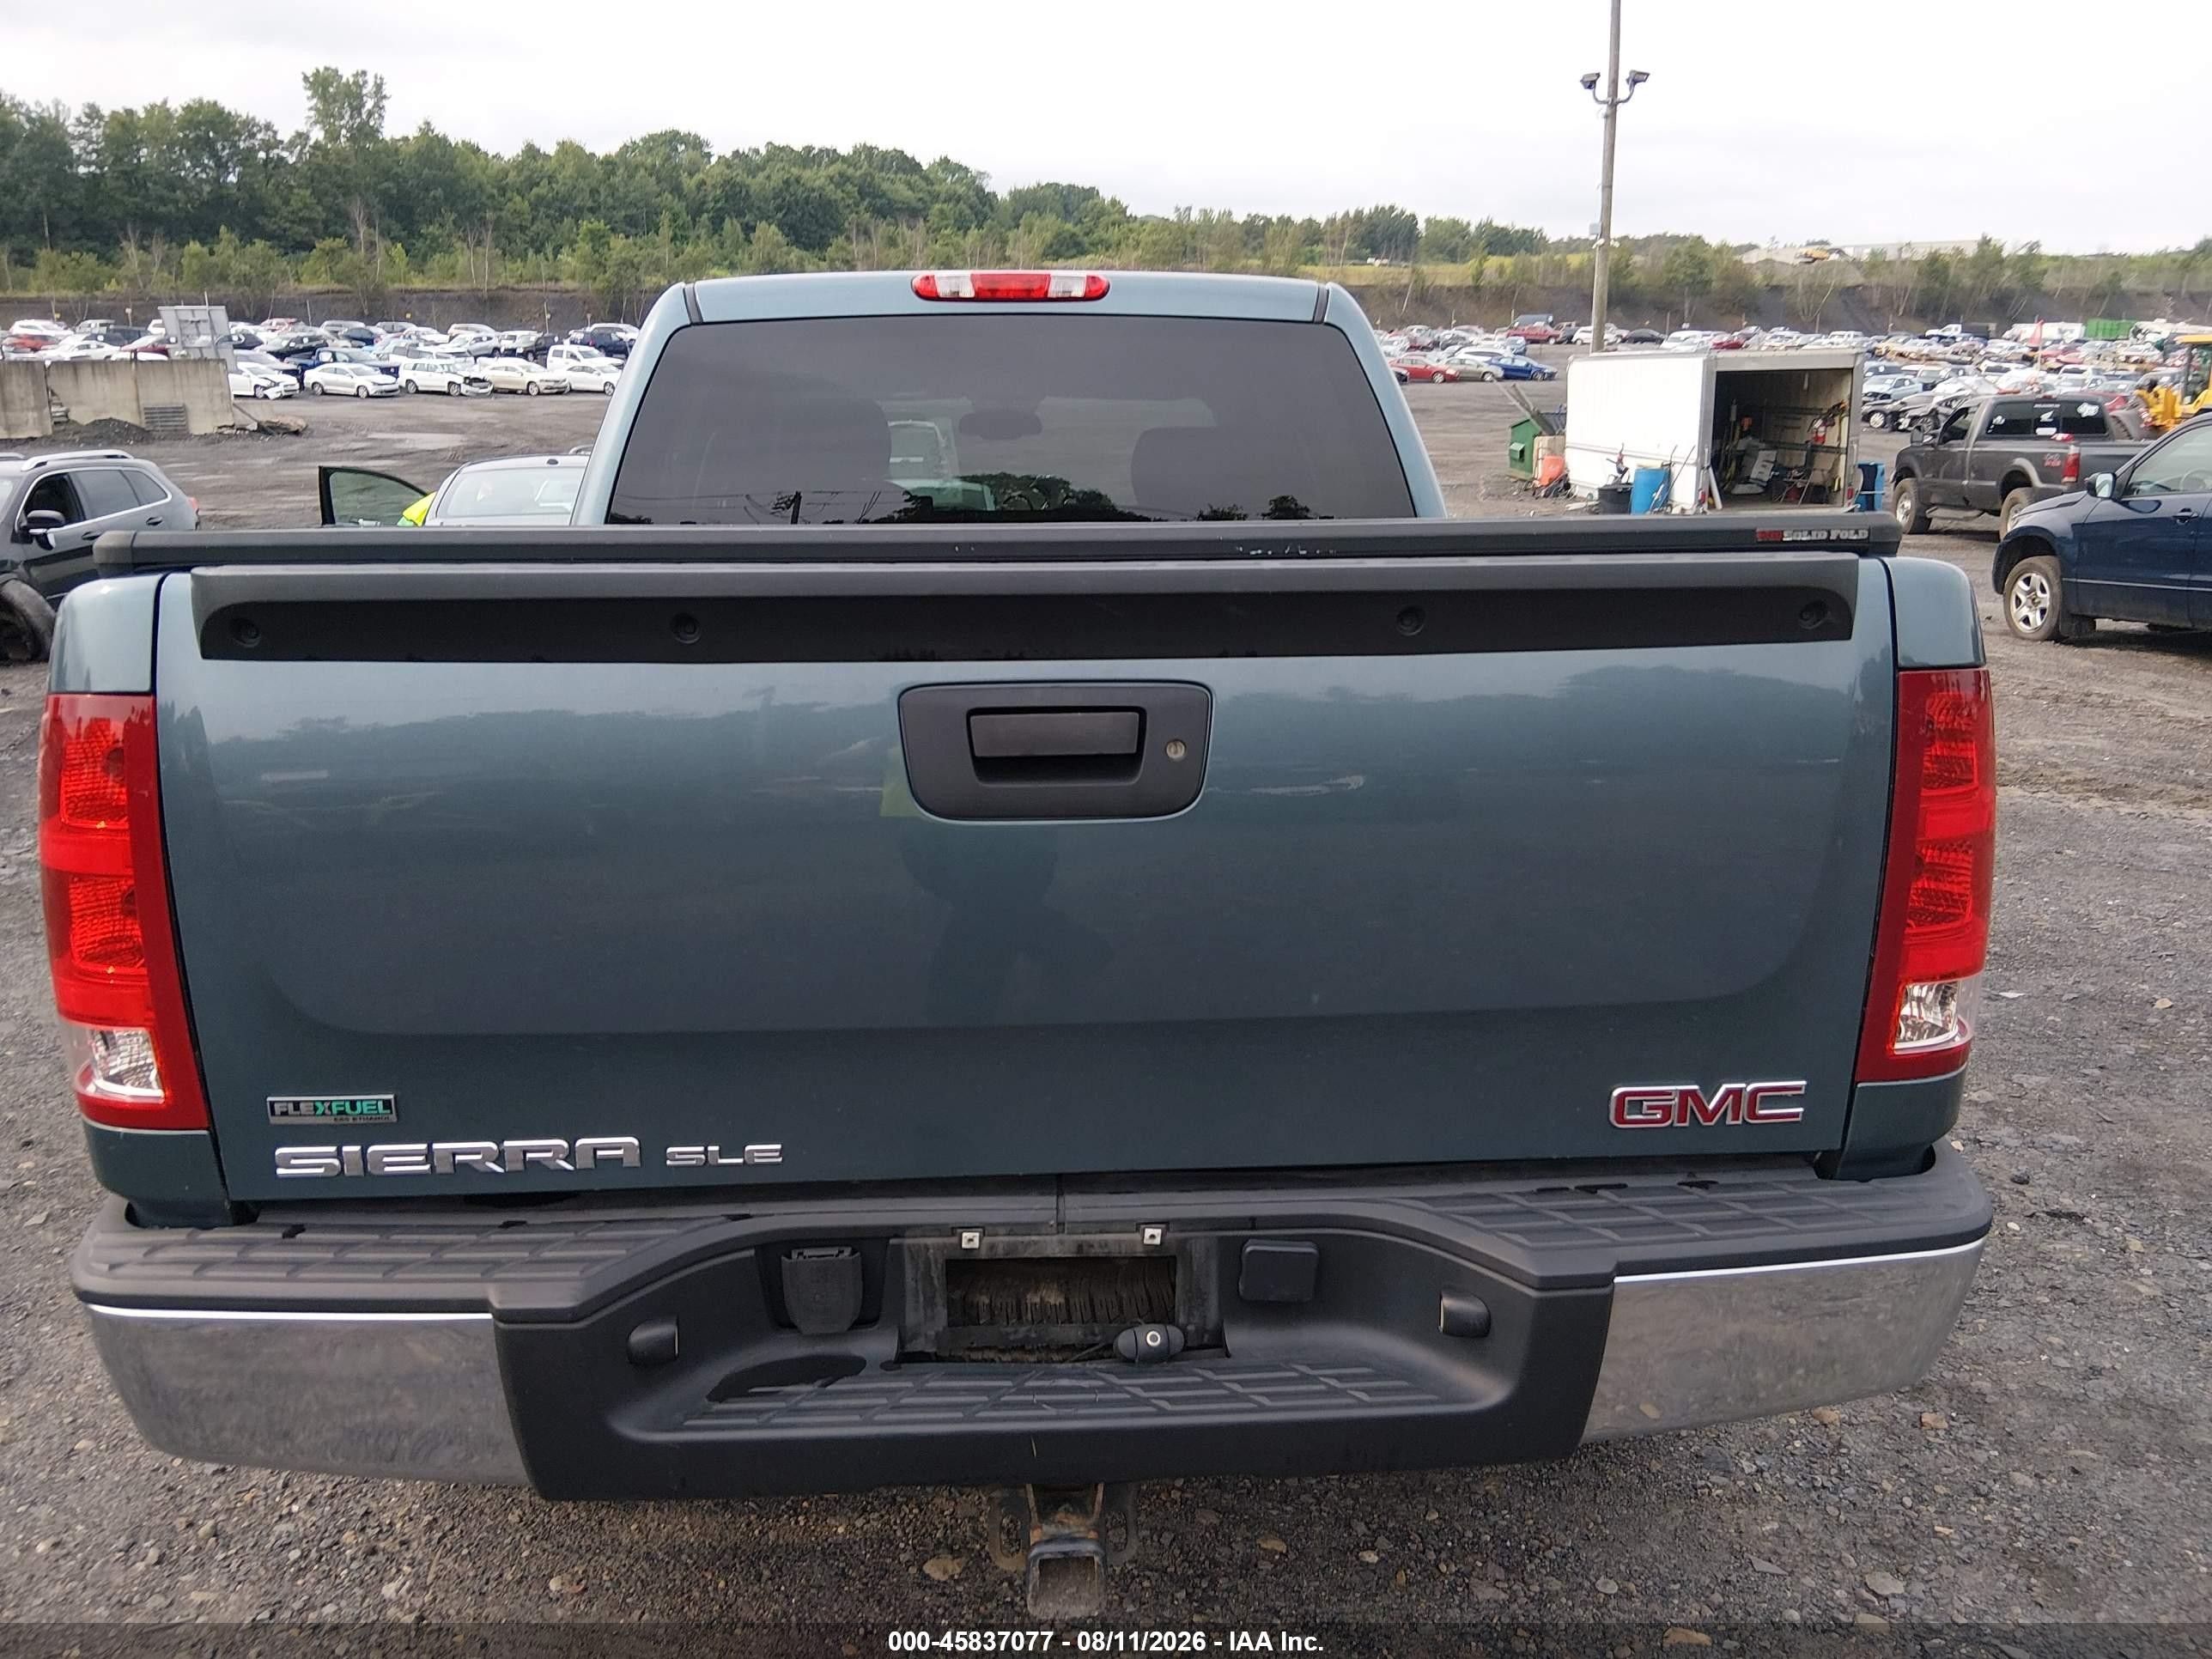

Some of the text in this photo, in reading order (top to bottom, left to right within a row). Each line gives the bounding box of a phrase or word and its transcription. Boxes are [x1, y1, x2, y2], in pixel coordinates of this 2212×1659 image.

[1782, 529, 1827, 541] SOLID
[1830, 529, 1869, 540] FOLD
[274, 1099, 392, 1115] FLEXFUEL
[1609, 1080, 1807, 1128] GMC
[275, 1136, 783, 1177] SIERRA SLE
